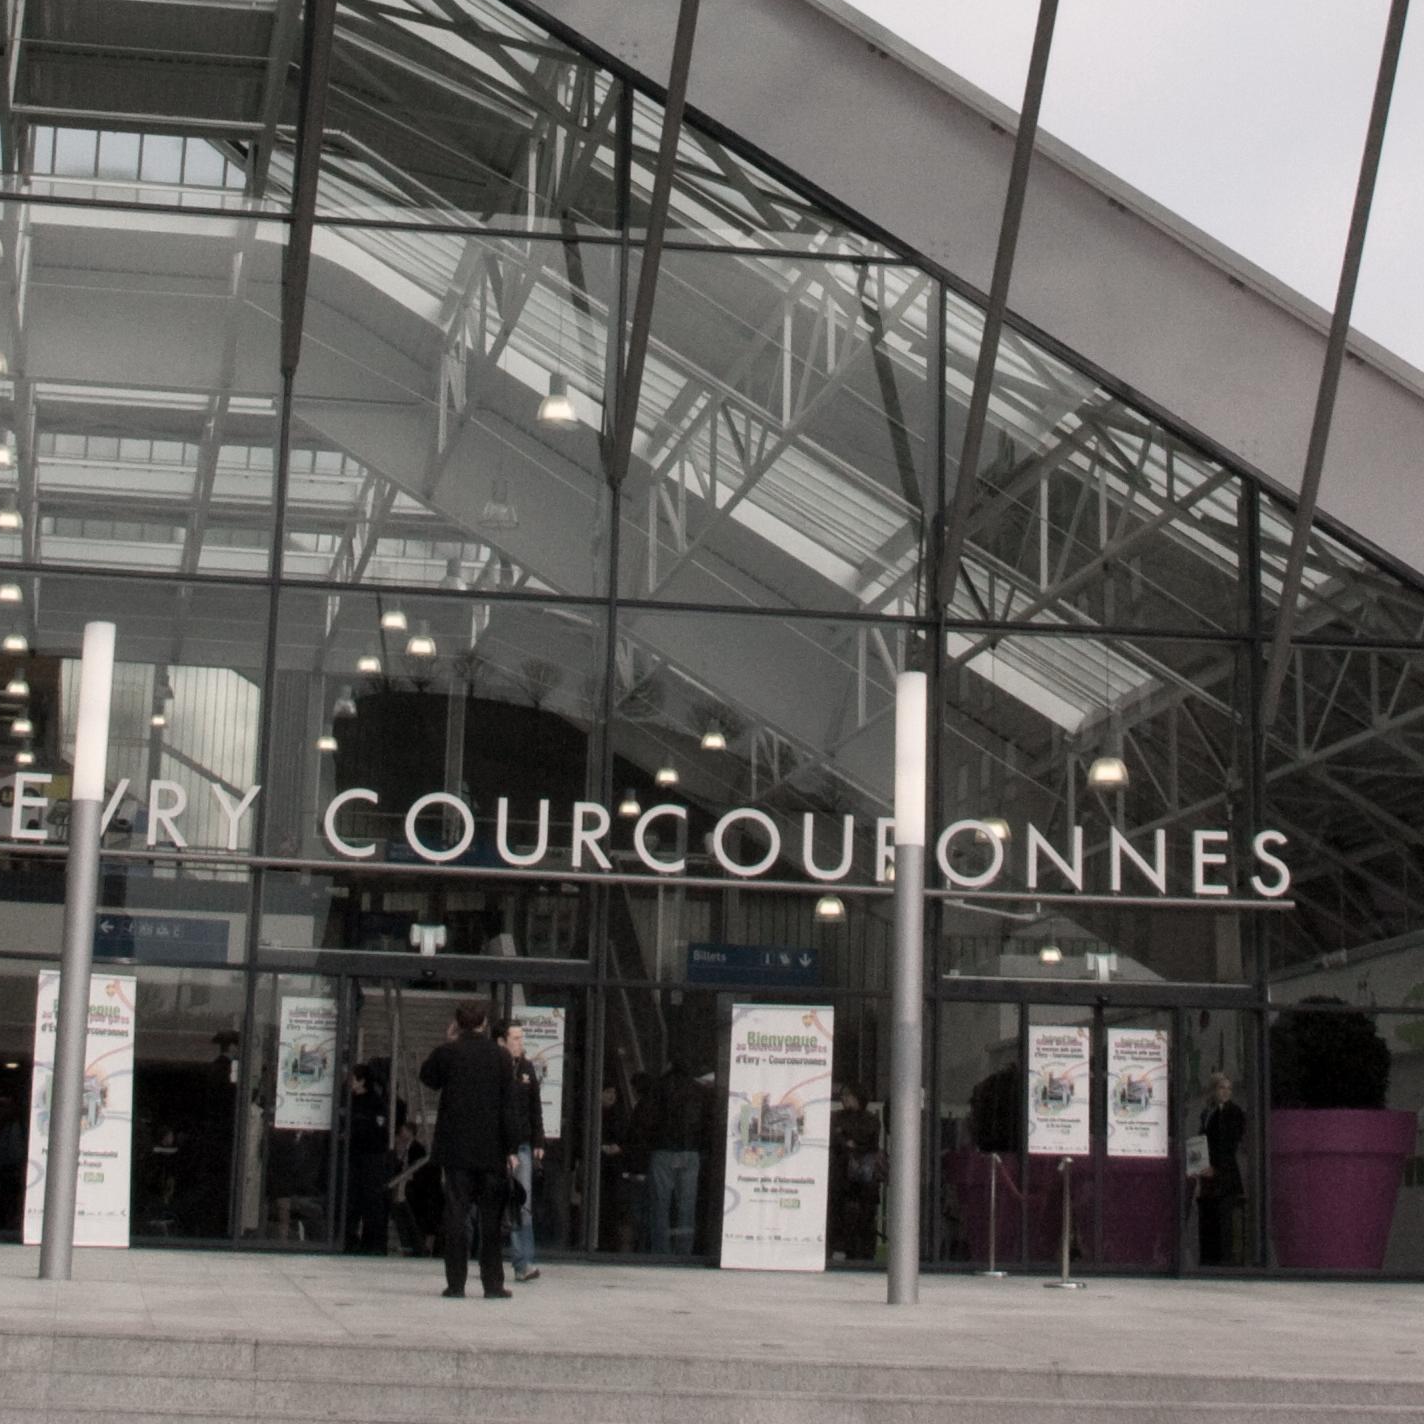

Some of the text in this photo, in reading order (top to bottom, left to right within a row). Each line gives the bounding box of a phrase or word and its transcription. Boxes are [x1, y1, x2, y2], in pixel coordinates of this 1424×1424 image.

[323, 788, 1291, 897] COURCOURONNES
[692, 949, 727, 963] Billets
[746, 1031, 818, 1048] Bienvenue
